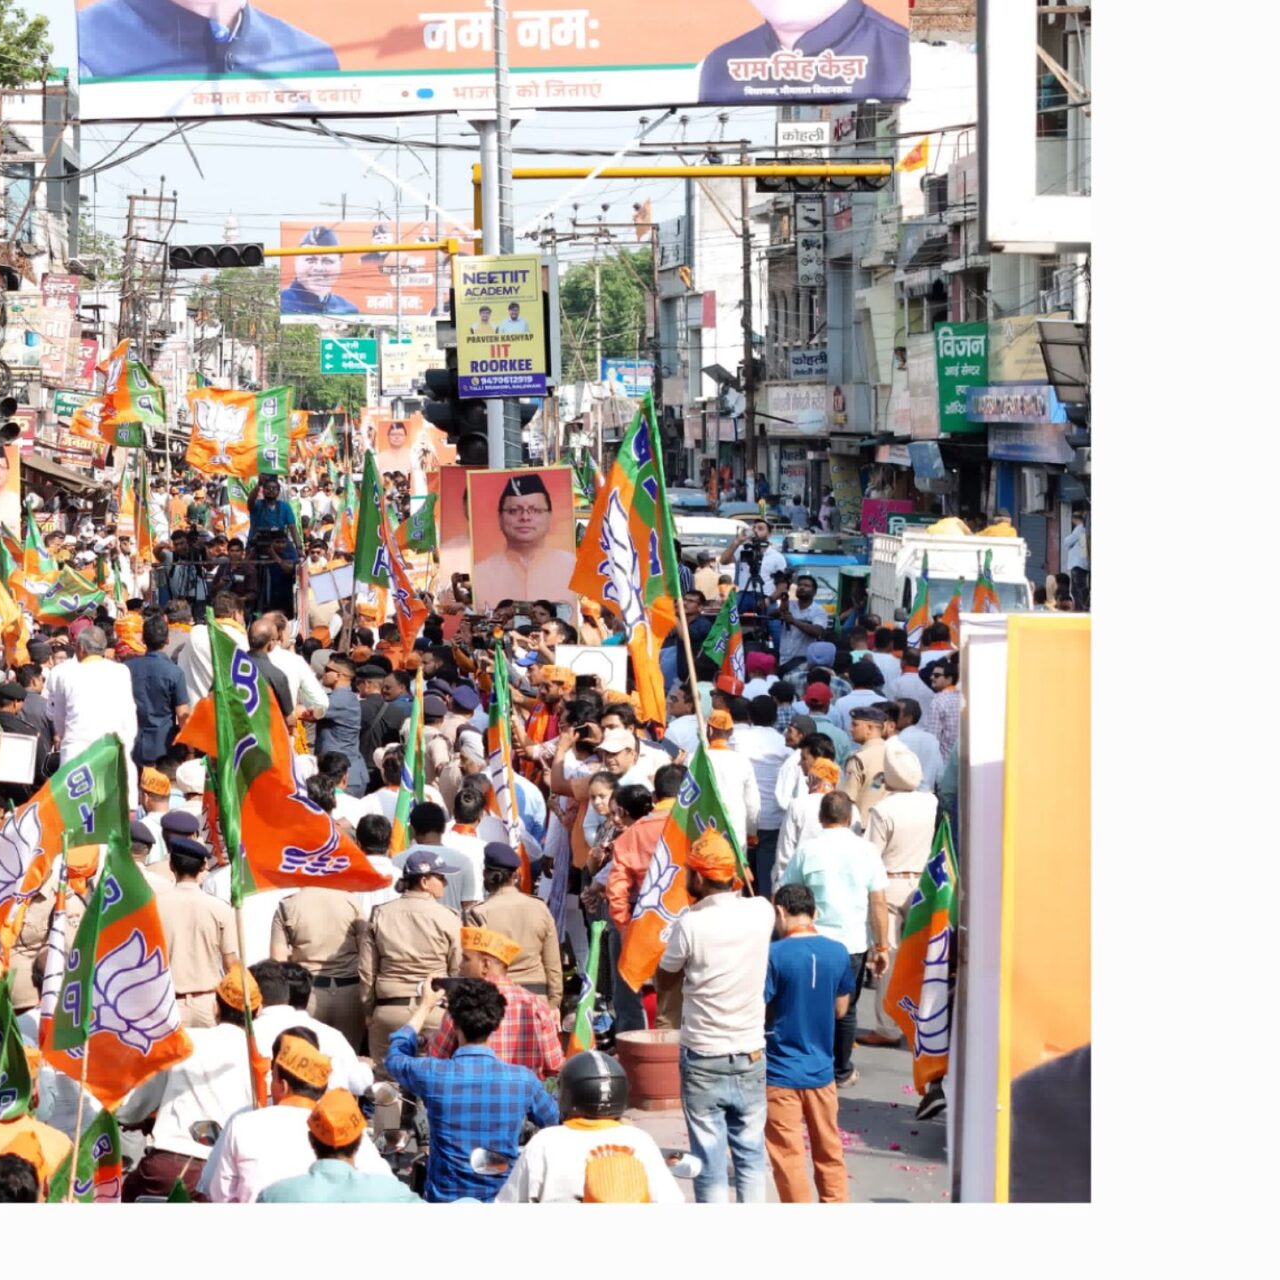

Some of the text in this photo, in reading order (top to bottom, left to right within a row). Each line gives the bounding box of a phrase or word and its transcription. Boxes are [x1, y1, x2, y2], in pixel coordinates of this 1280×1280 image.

[729, 58, 767, 80] राम
[773, 54, 815, 81] सिंह
[193, 91, 241, 106] कमल
[246, 91, 269, 105] का
[274, 91, 311, 104] बटन
[782, 128, 824, 142] कोहली
[463, 270, 529, 285] NEETIIT
[465, 286, 521, 297] ACADEMY
[466, 333, 534, 343] PRAVEEN KASHYAP
[490, 344, 511, 358] IIT
[470, 359, 533, 373] ROORKEE
